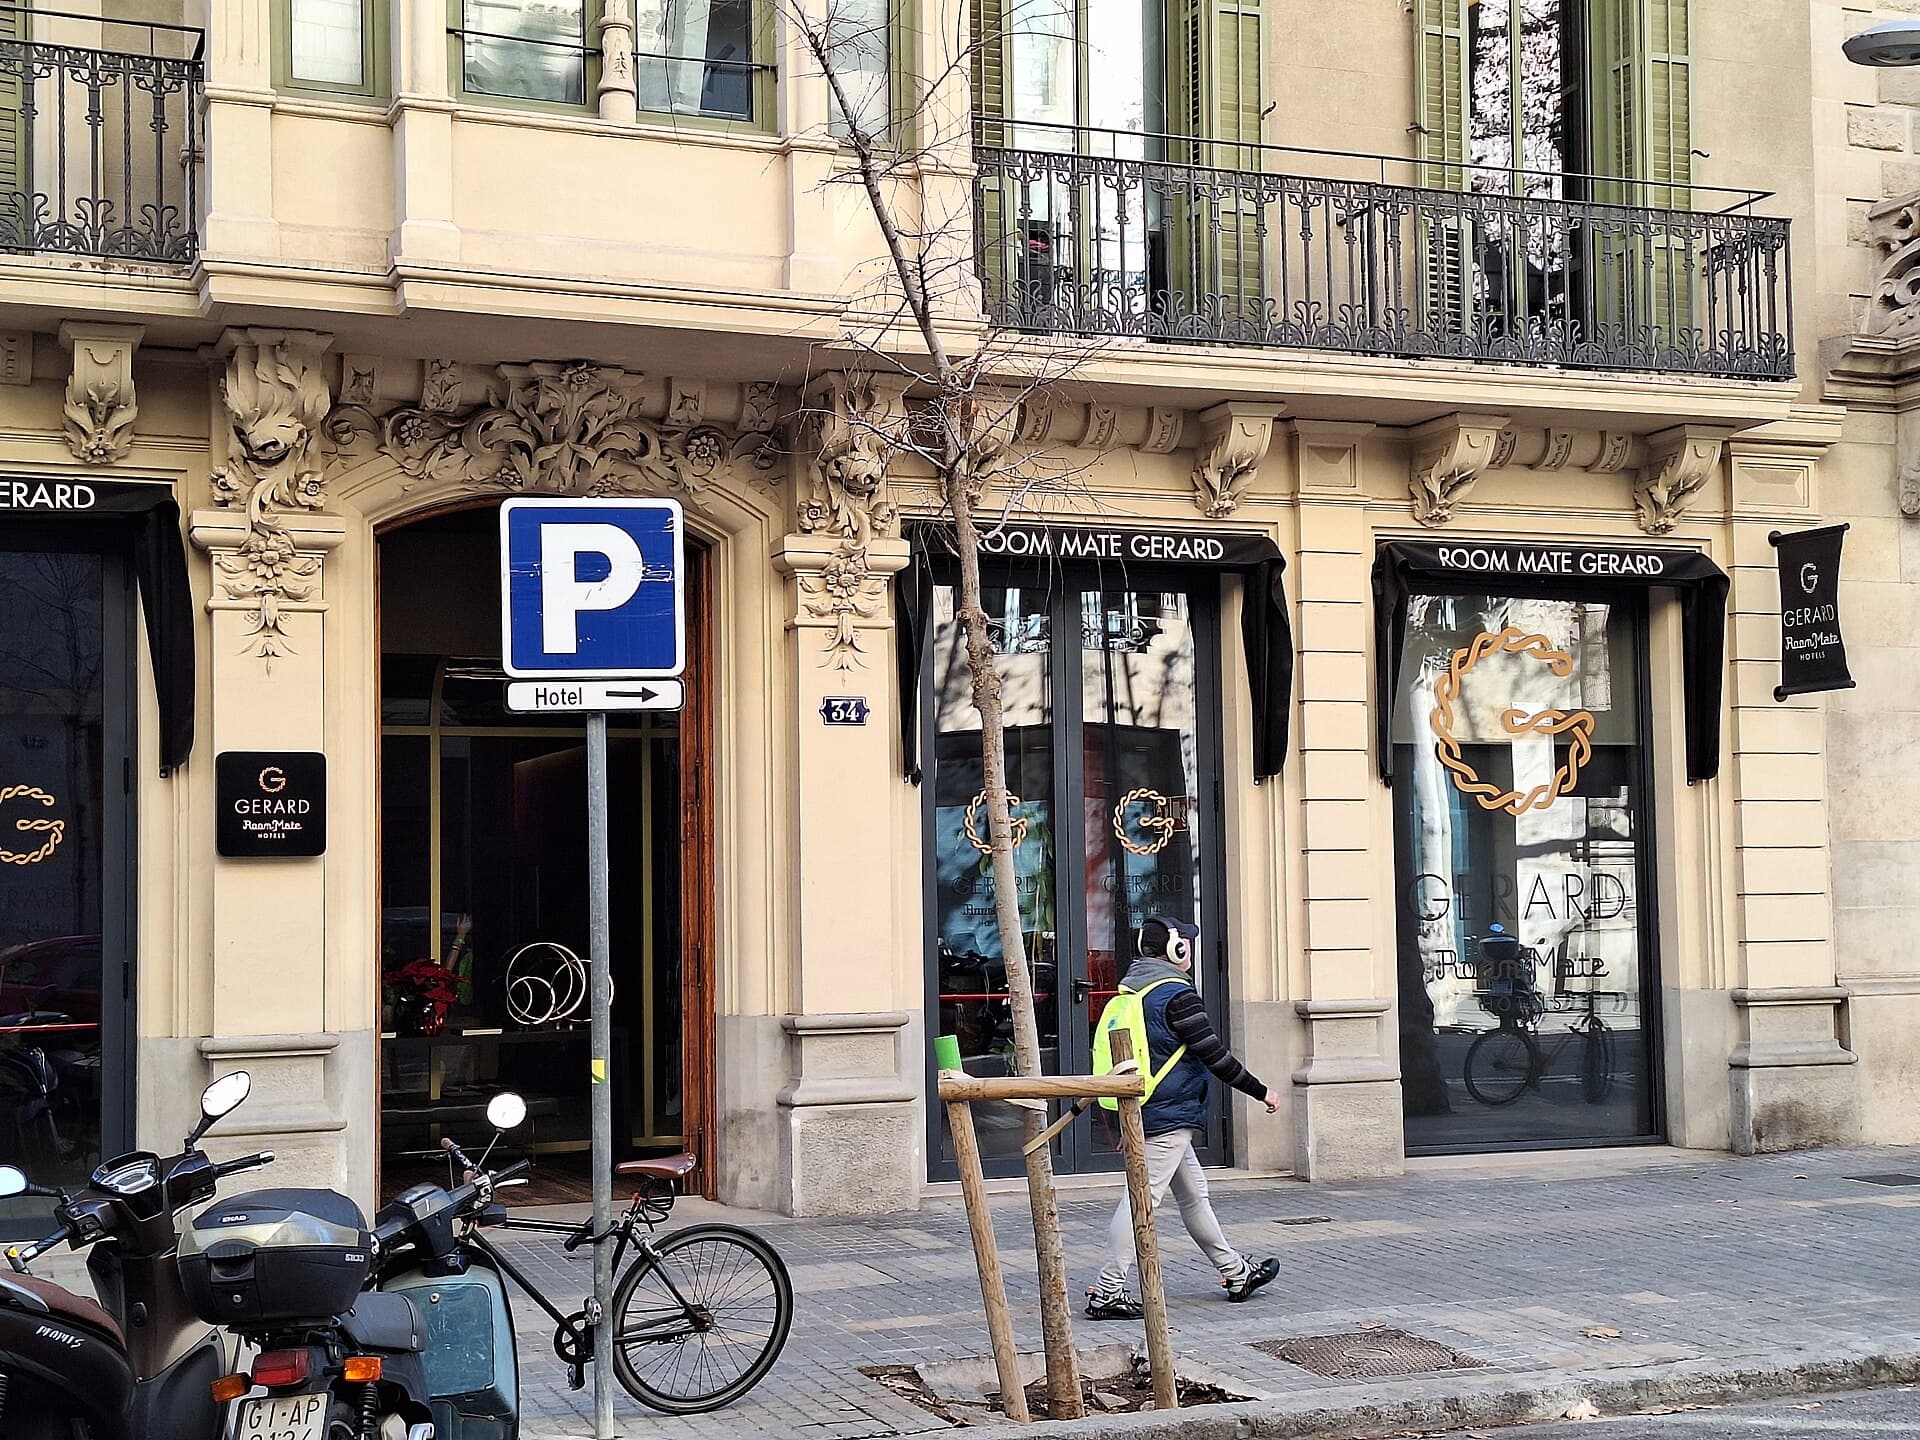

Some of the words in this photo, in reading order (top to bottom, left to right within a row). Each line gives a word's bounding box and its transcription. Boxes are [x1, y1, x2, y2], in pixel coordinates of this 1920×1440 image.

[1060, 532, 1122, 557] MATE
[1130, 534, 1224, 560] GERARD
[1438, 547, 1511, 571] ROOM
[1517, 550, 1573, 573] MATE
[1579, 552, 1664, 575] GERARD
[540, 523, 644, 654] P
[1783, 604, 1835, 627] GERARD
[1799, 651, 1826, 661] HOTELS
[535, 687, 583, 706] Hotel
[831, 700, 860, 721] 34
[234, 799, 310, 814] GERARD
[1408, 873, 1626, 921] GERARD
